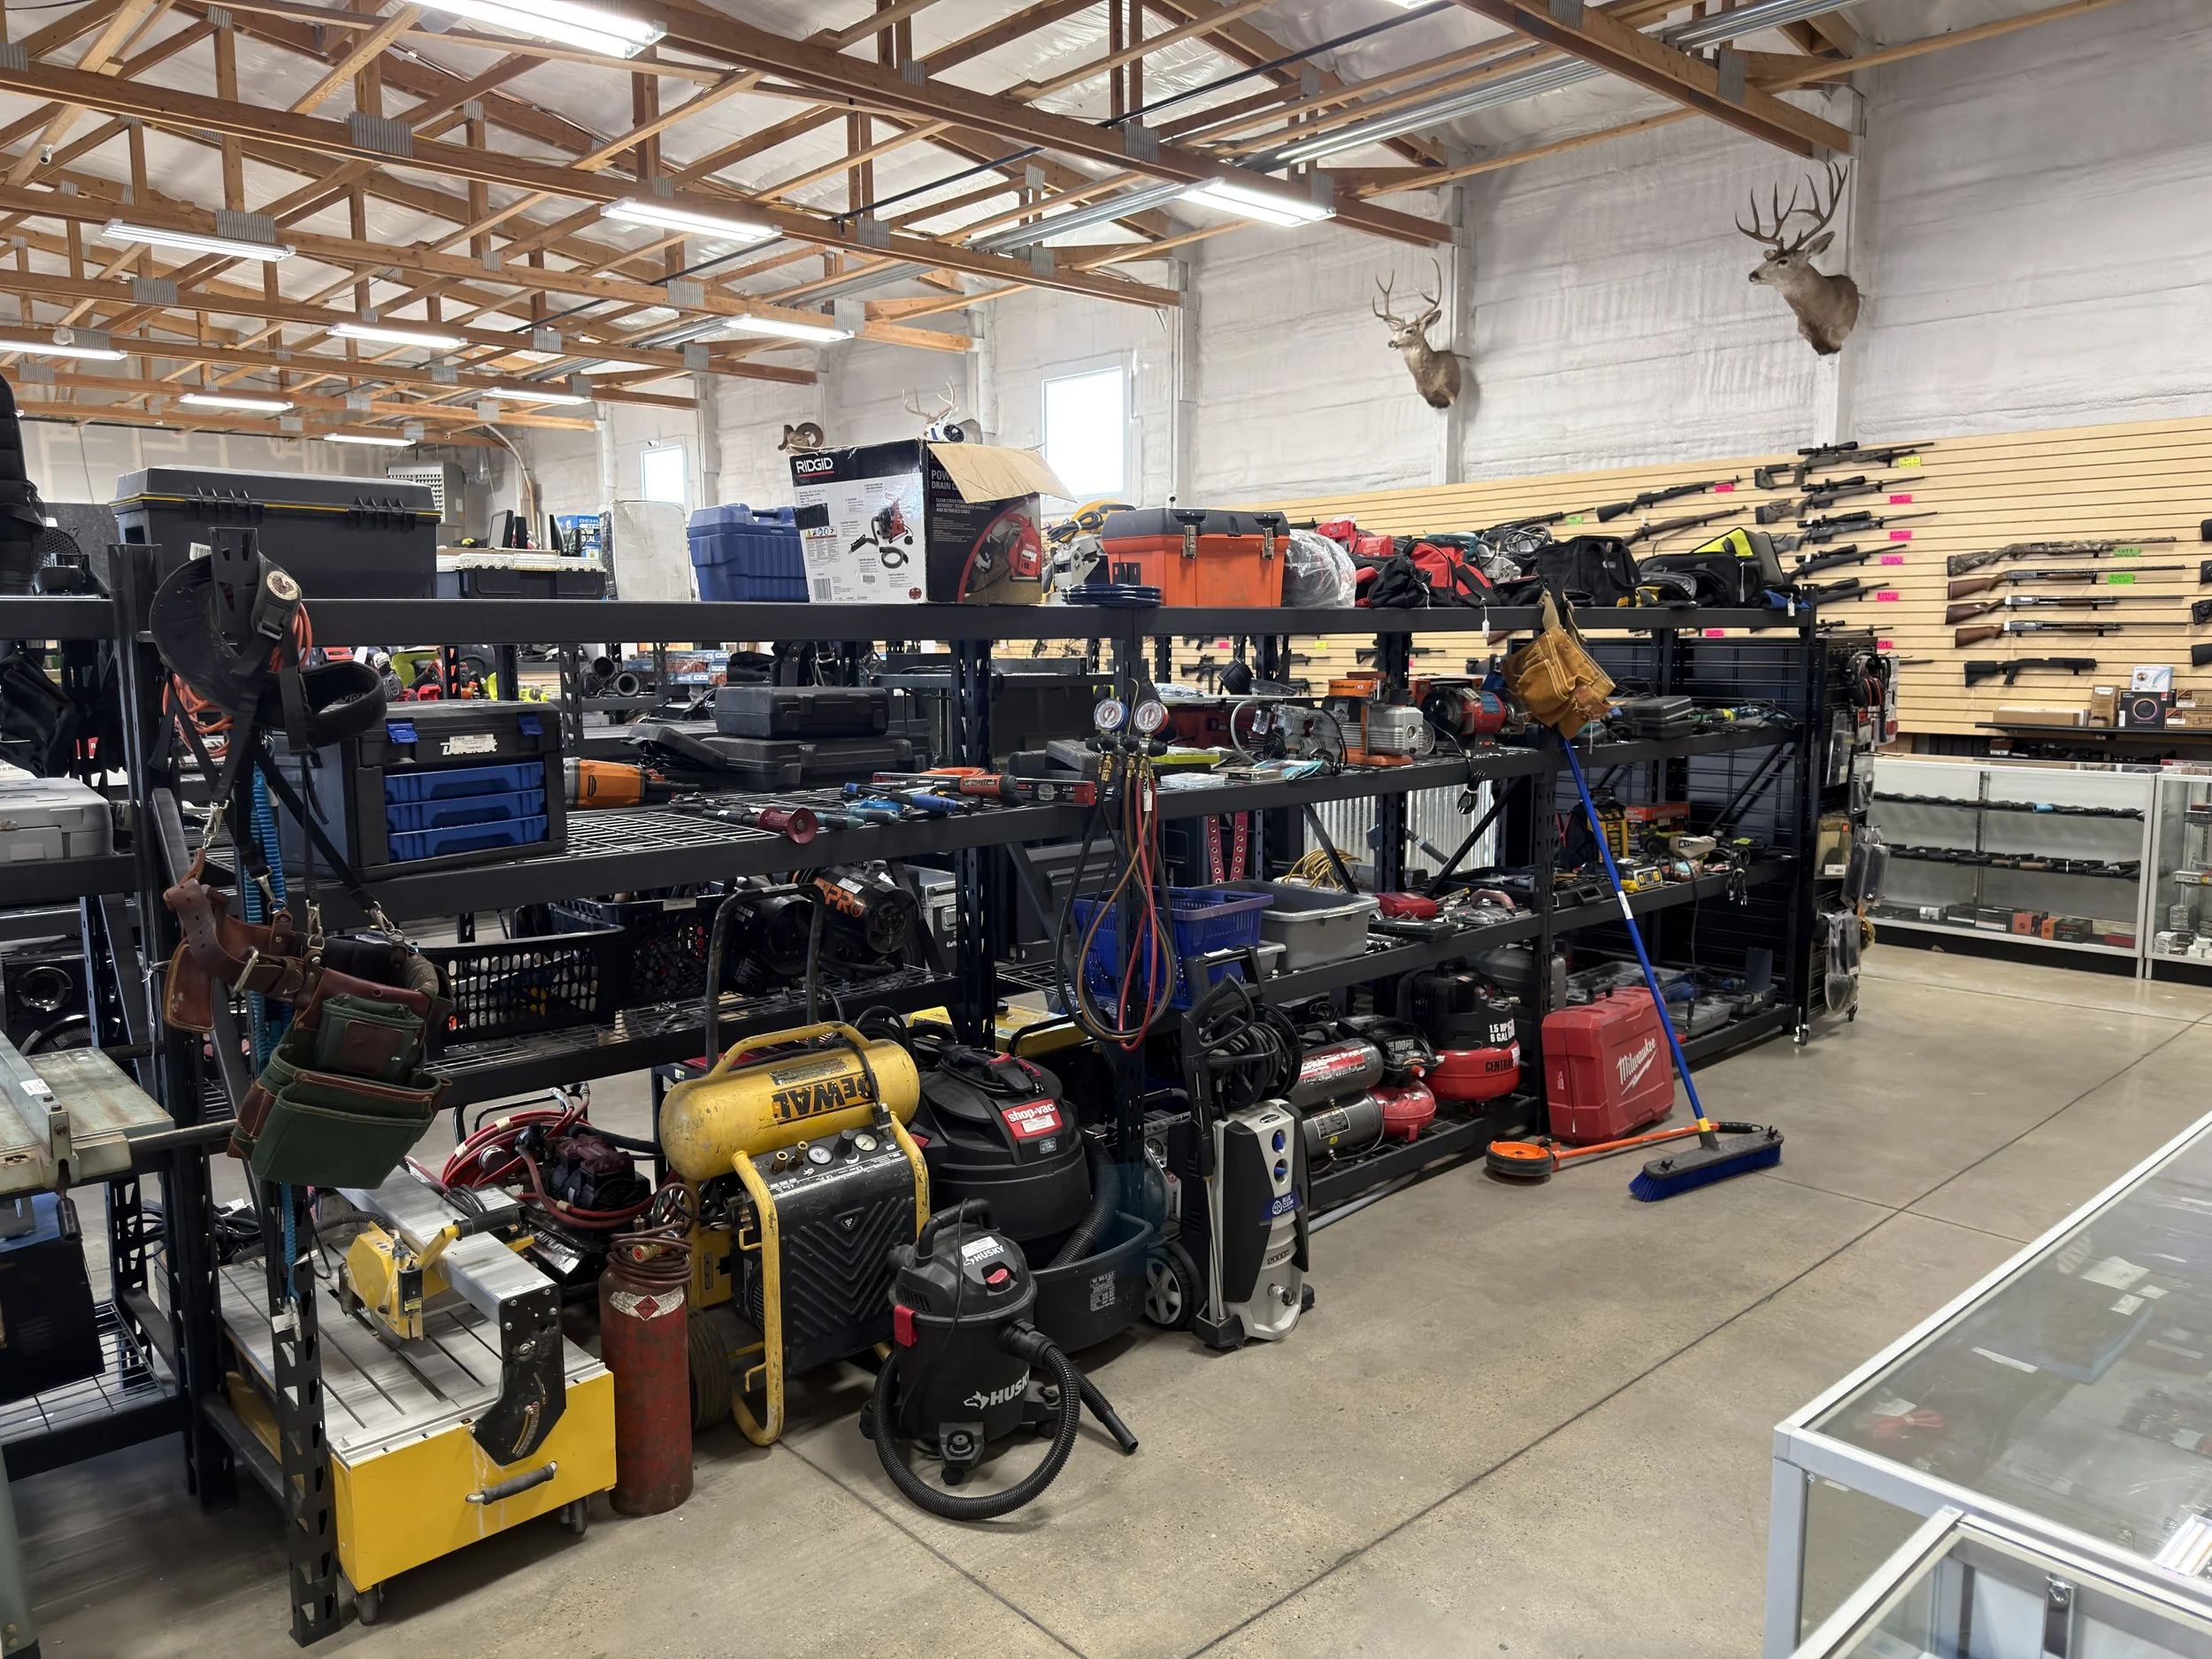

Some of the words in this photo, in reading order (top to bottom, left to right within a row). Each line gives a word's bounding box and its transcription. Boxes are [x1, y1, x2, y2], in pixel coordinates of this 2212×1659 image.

[795, 457, 833, 474] RIDGID
[931, 469, 953, 480] POW
[931, 480, 951, 491] DRAIN
[1489, 1024, 1499, 1033] 1.5
[1490, 1033, 1496, 1042] 6
[1496, 1032, 1509, 1042] GAL
[1486, 1058, 1513, 1073] CENTRA
[1616, 1037, 1656, 1085] Milwaukee
[973, 1244, 1005, 1263] HUSKY
[1267, 1251, 1286, 1265] 2000
